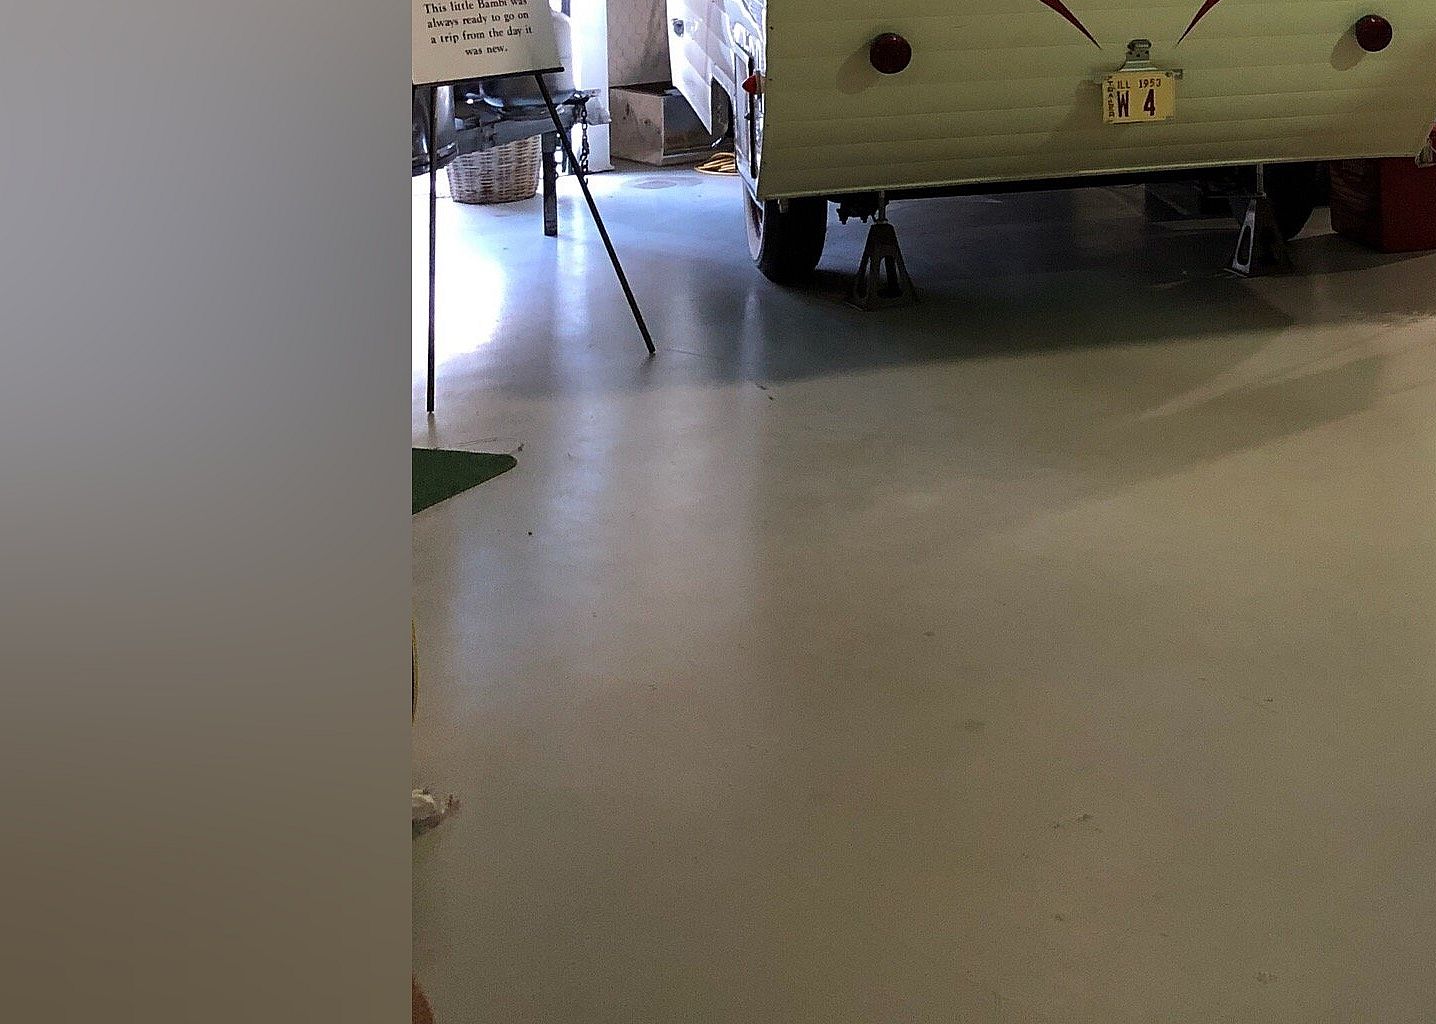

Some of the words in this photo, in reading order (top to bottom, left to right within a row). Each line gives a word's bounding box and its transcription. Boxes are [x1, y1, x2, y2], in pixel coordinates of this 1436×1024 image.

[424, 3, 447, 14] This
[450, 1, 474, 11] little
[427, 17, 459, 29] always
[462, 13, 488, 25] ready
[491, 13, 501, 22] to
[504, 13, 515, 23] go
[518, 12, 529, 21] on
[431, 36, 437, 44] a
[440, 32, 459, 44] trip
[462, 30, 485, 41] from
[489, 28, 503, 38] the
[507, 26, 523, 37] day
[524, 25, 532, 34] it
[465, 48, 483, 56] was
[487, 45, 508, 55] new.
[1117, 80, 1131, 89] ILL
[1139, 79, 1161, 89] 1953
[1117, 90, 1130, 117] W
[1143, 89, 1155, 116] 4
